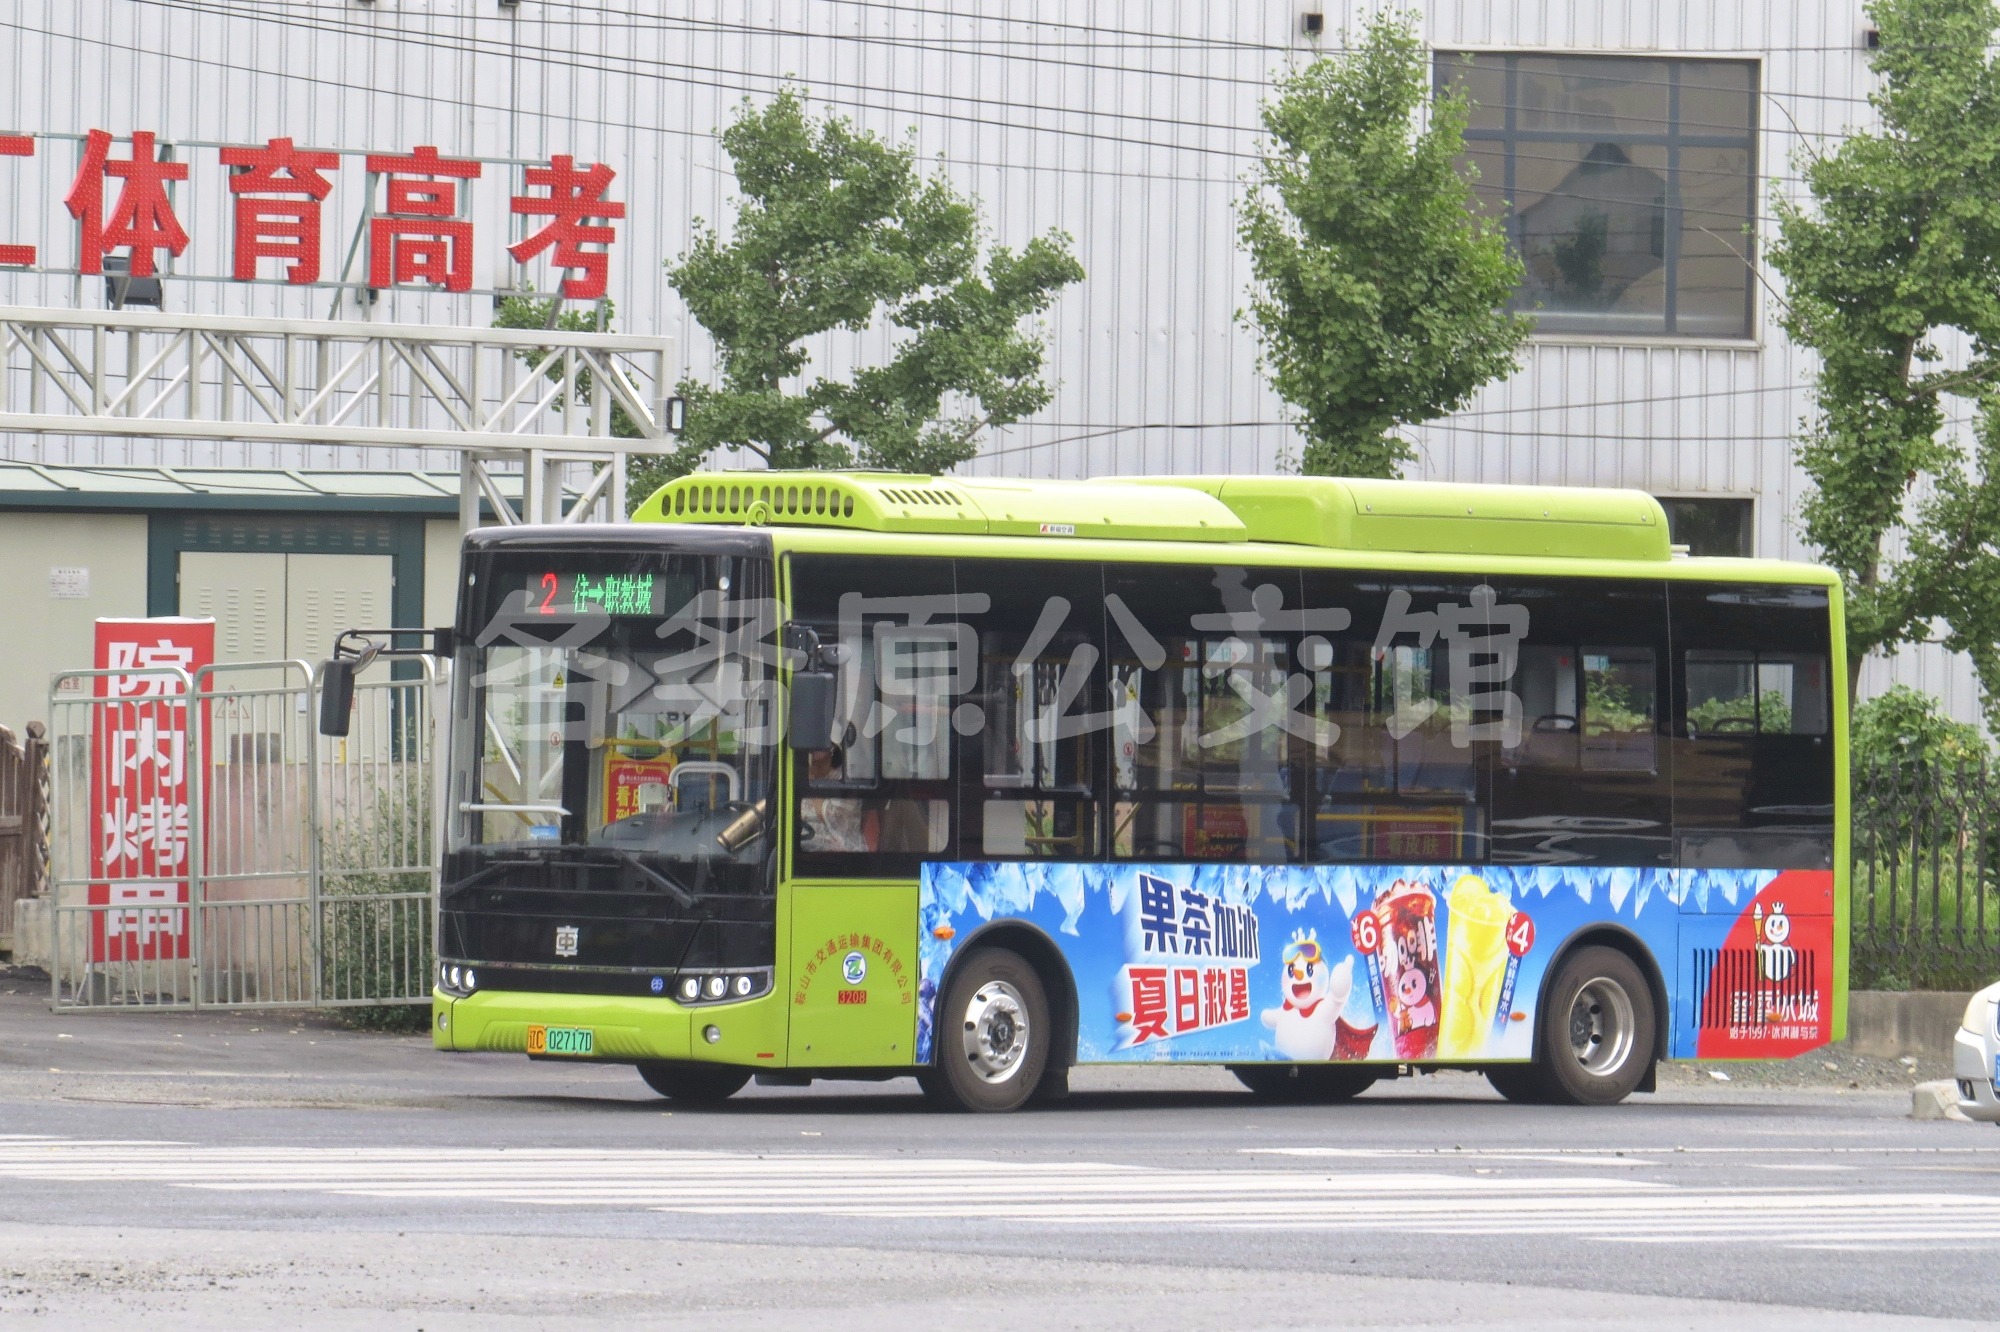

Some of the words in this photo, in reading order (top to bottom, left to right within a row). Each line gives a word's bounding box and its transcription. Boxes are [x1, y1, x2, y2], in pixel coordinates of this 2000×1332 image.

[540, 573, 557, 614] 2
[100, 639, 194, 945] 院内烤串
[1139, 873, 1259, 960] 果茶加冰
[840, 990, 867, 1004] 3208
[1128, 967, 1249, 1044] 夏日救星
